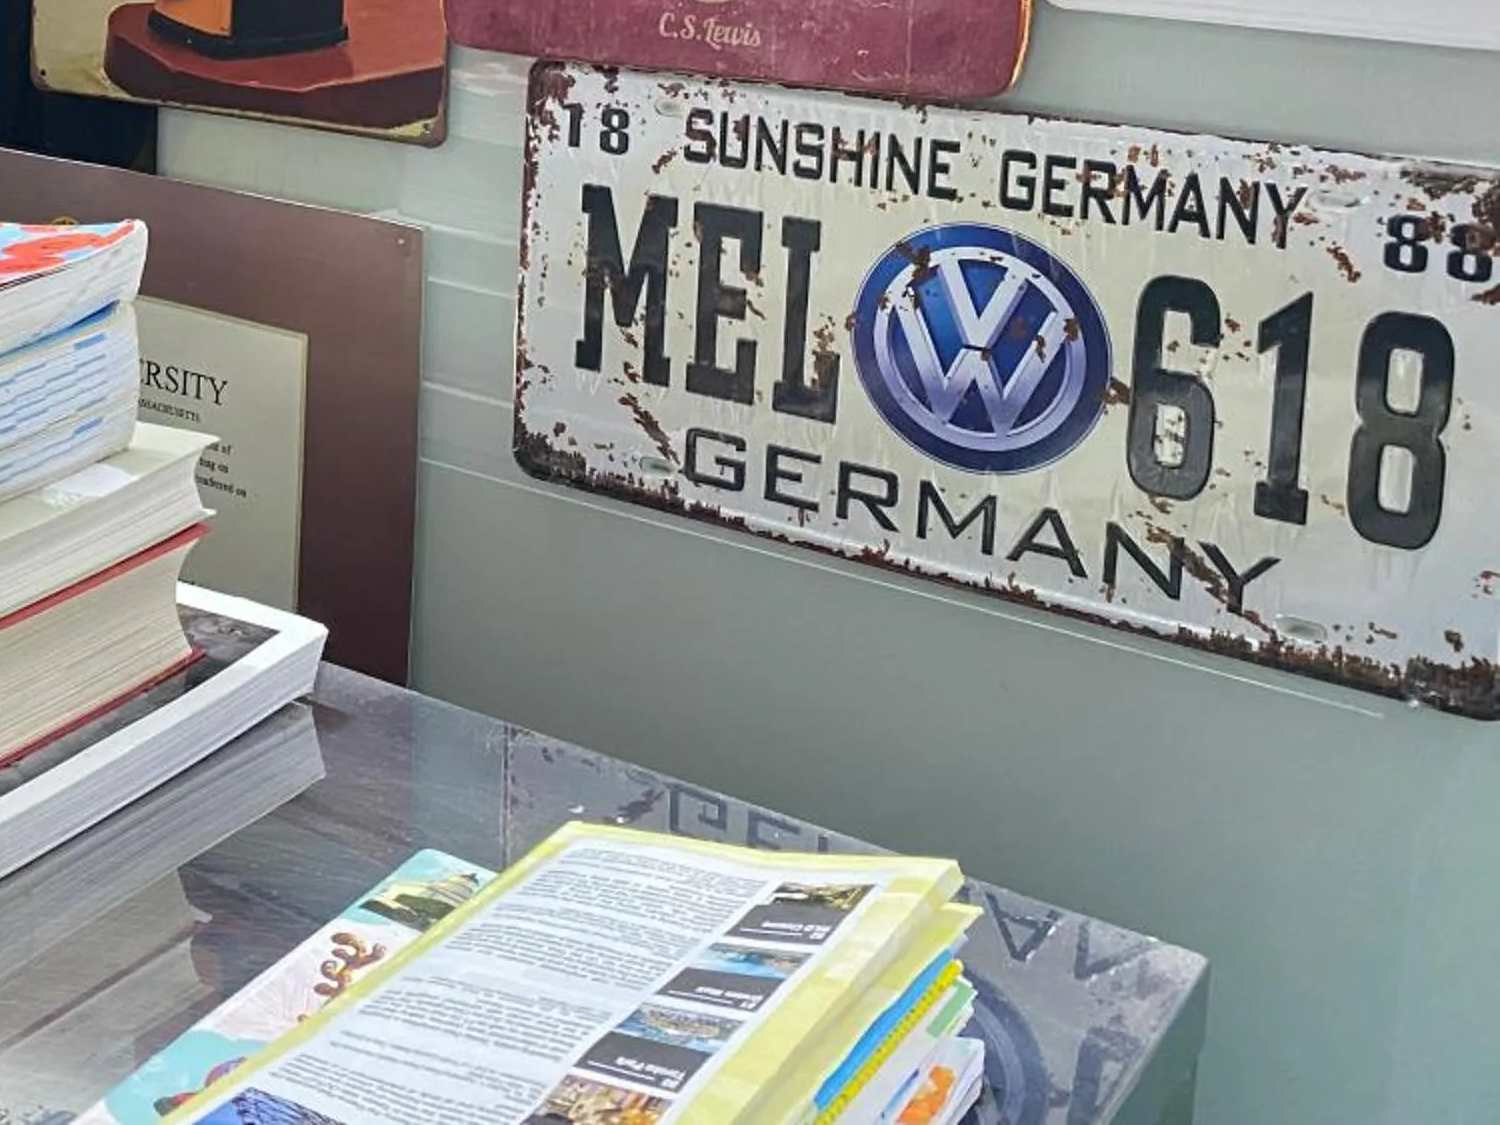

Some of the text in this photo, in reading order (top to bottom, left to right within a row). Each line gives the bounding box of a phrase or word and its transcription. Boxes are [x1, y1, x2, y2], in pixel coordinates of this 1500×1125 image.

[683, 106, 962, 202] SUNSHINE
[1000, 148, 1309, 250] GERMANY
[1384, 214, 1494, 283] 88
[575, 183, 841, 424] MEL
[683, 426, 1281, 613] GERMANY
[1125, 274, 1456, 551] 618
